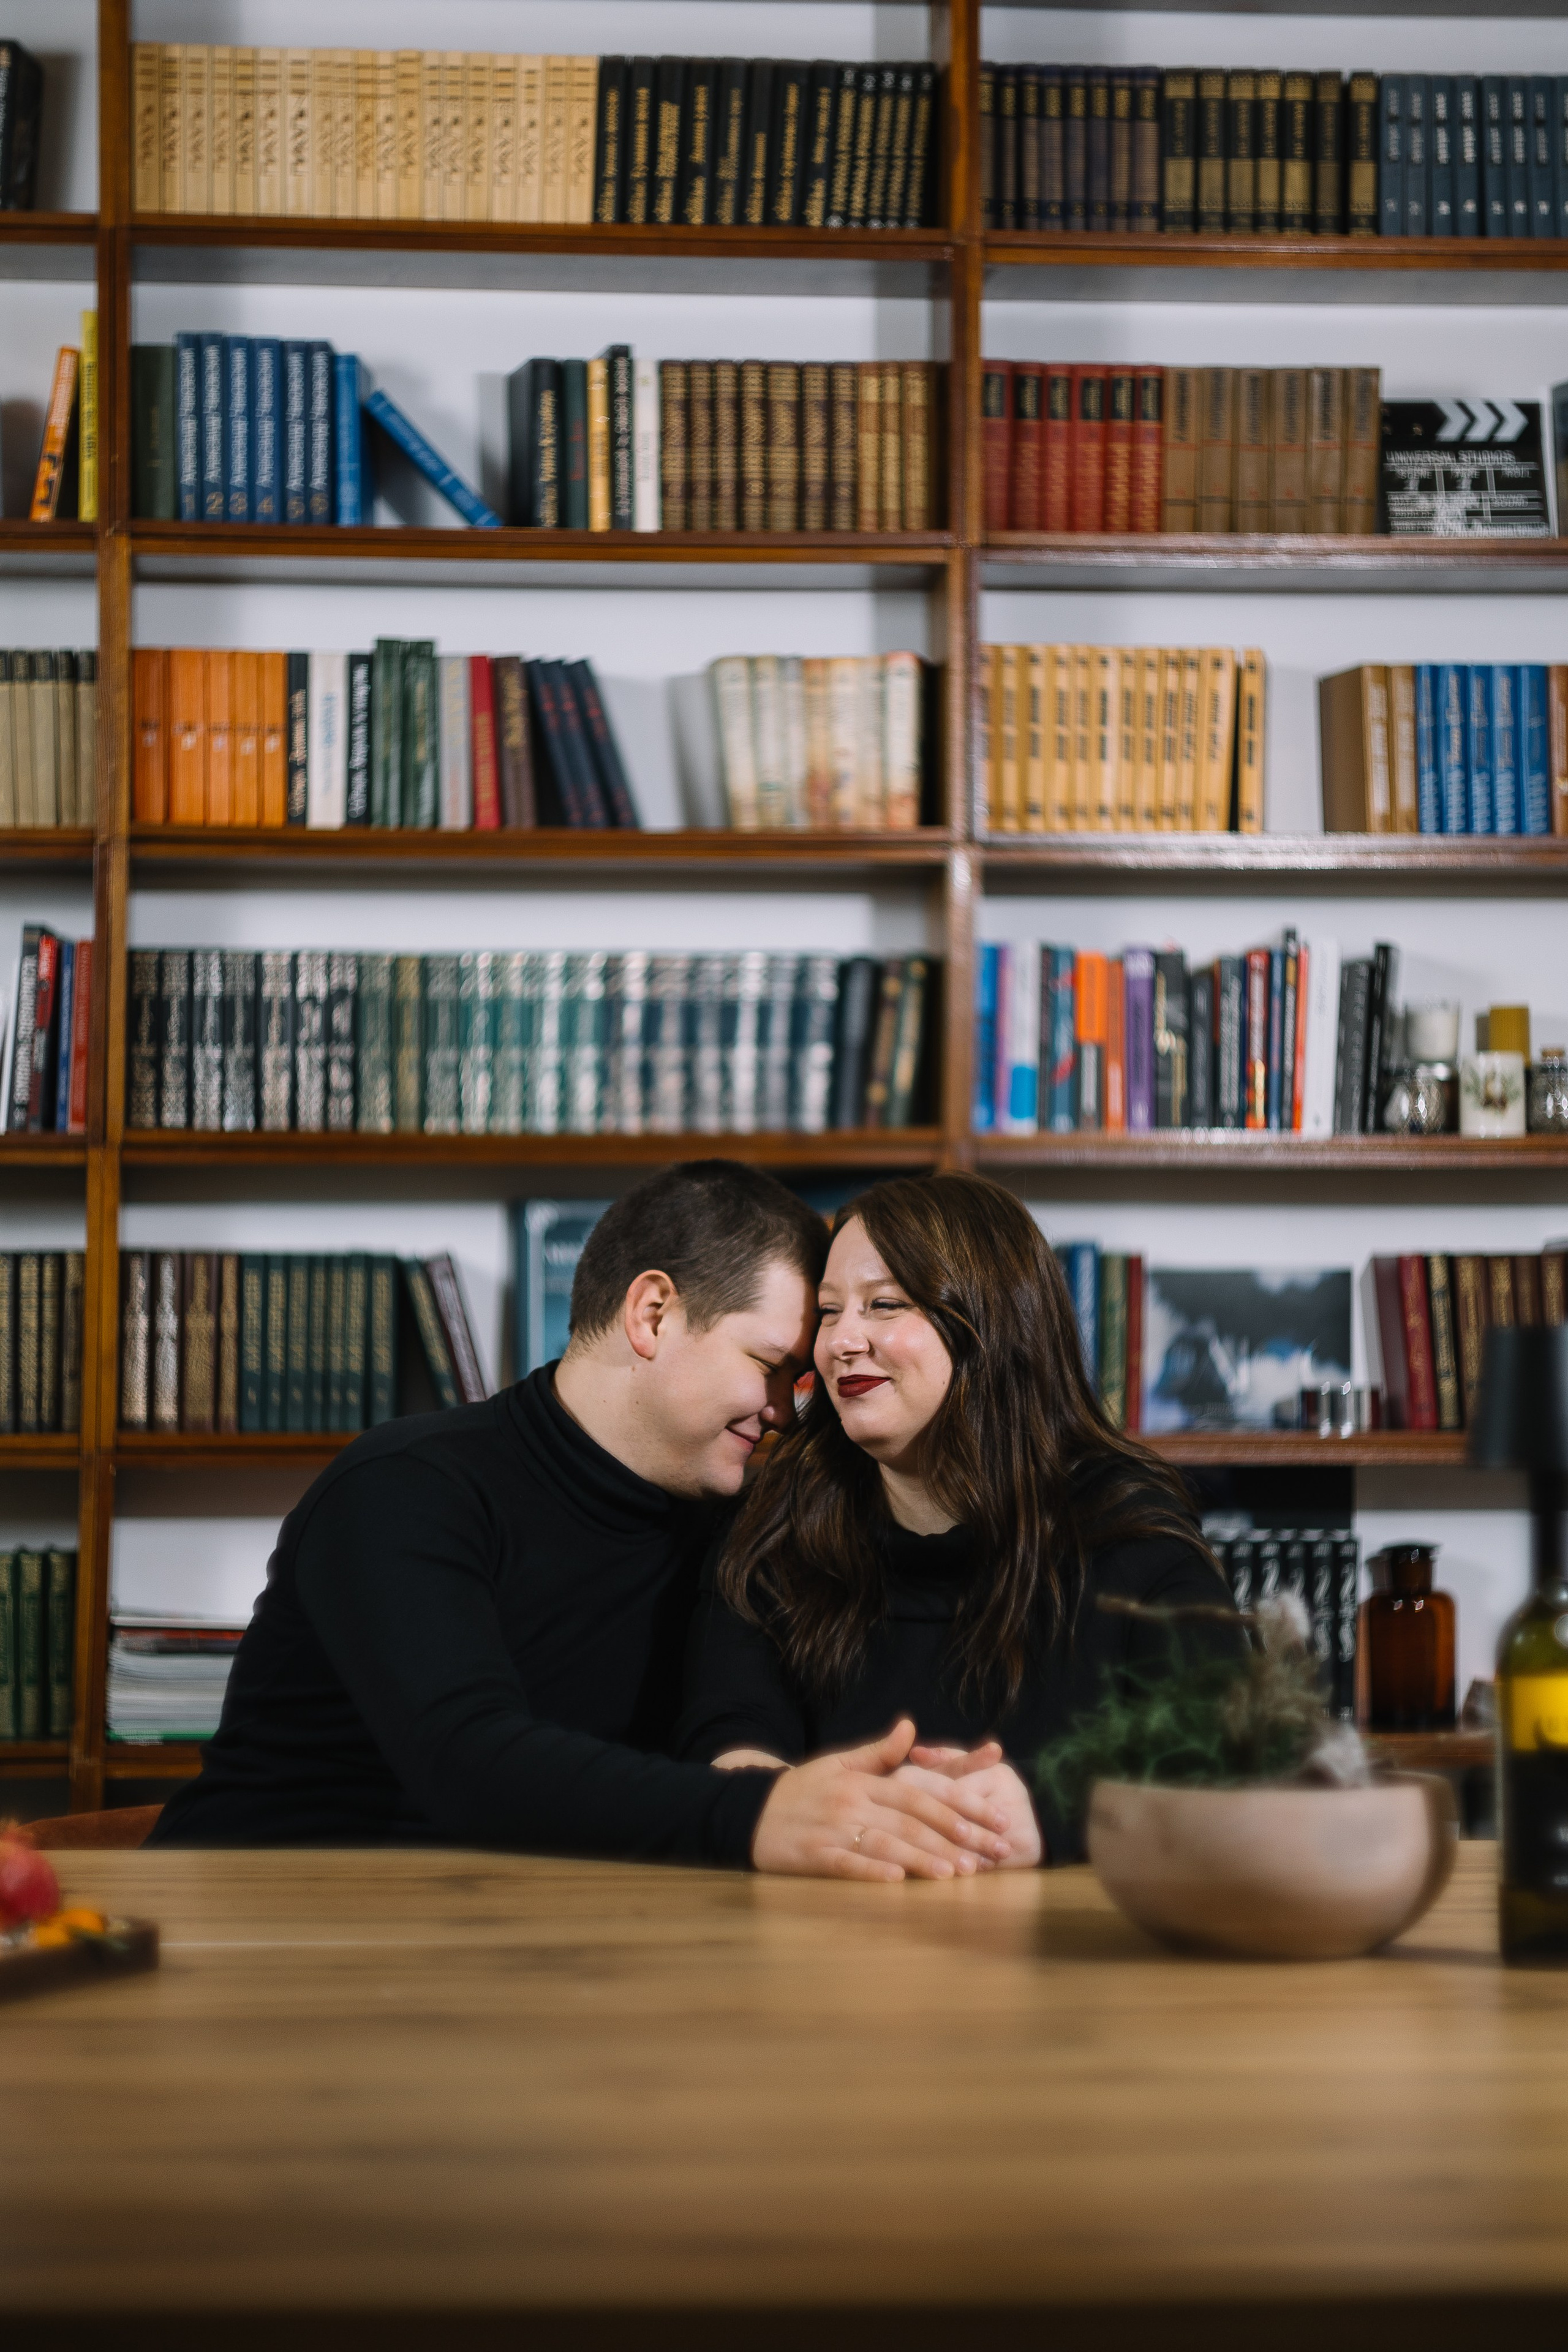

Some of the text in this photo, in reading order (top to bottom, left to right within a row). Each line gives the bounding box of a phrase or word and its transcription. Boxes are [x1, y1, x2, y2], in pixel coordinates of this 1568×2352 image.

[179, 348, 196, 416] Чаковский
[203, 345, 221, 413] Чаковский
[229, 348, 247, 417] Чаковский
[255, 348, 273, 417] Чаковский
[285, 352, 304, 421] Чаковский
[309, 352, 328, 420] Чаковский
[614, 356, 631, 395] ЖИЗНИ
[203, 412, 222, 483] Александр
[614, 396, 632, 434] СМЫСЛ
[180, 415, 197, 486] Александр
[229, 416, 249, 488] Александр
[255, 417, 275, 488] Александр
[285, 420, 305, 492] Александр
[309, 419, 330, 490] Александр
[1385, 450, 1517, 463] UNIVERSAL STUDIOS
[1395, 466, 1433, 479] SCENE
